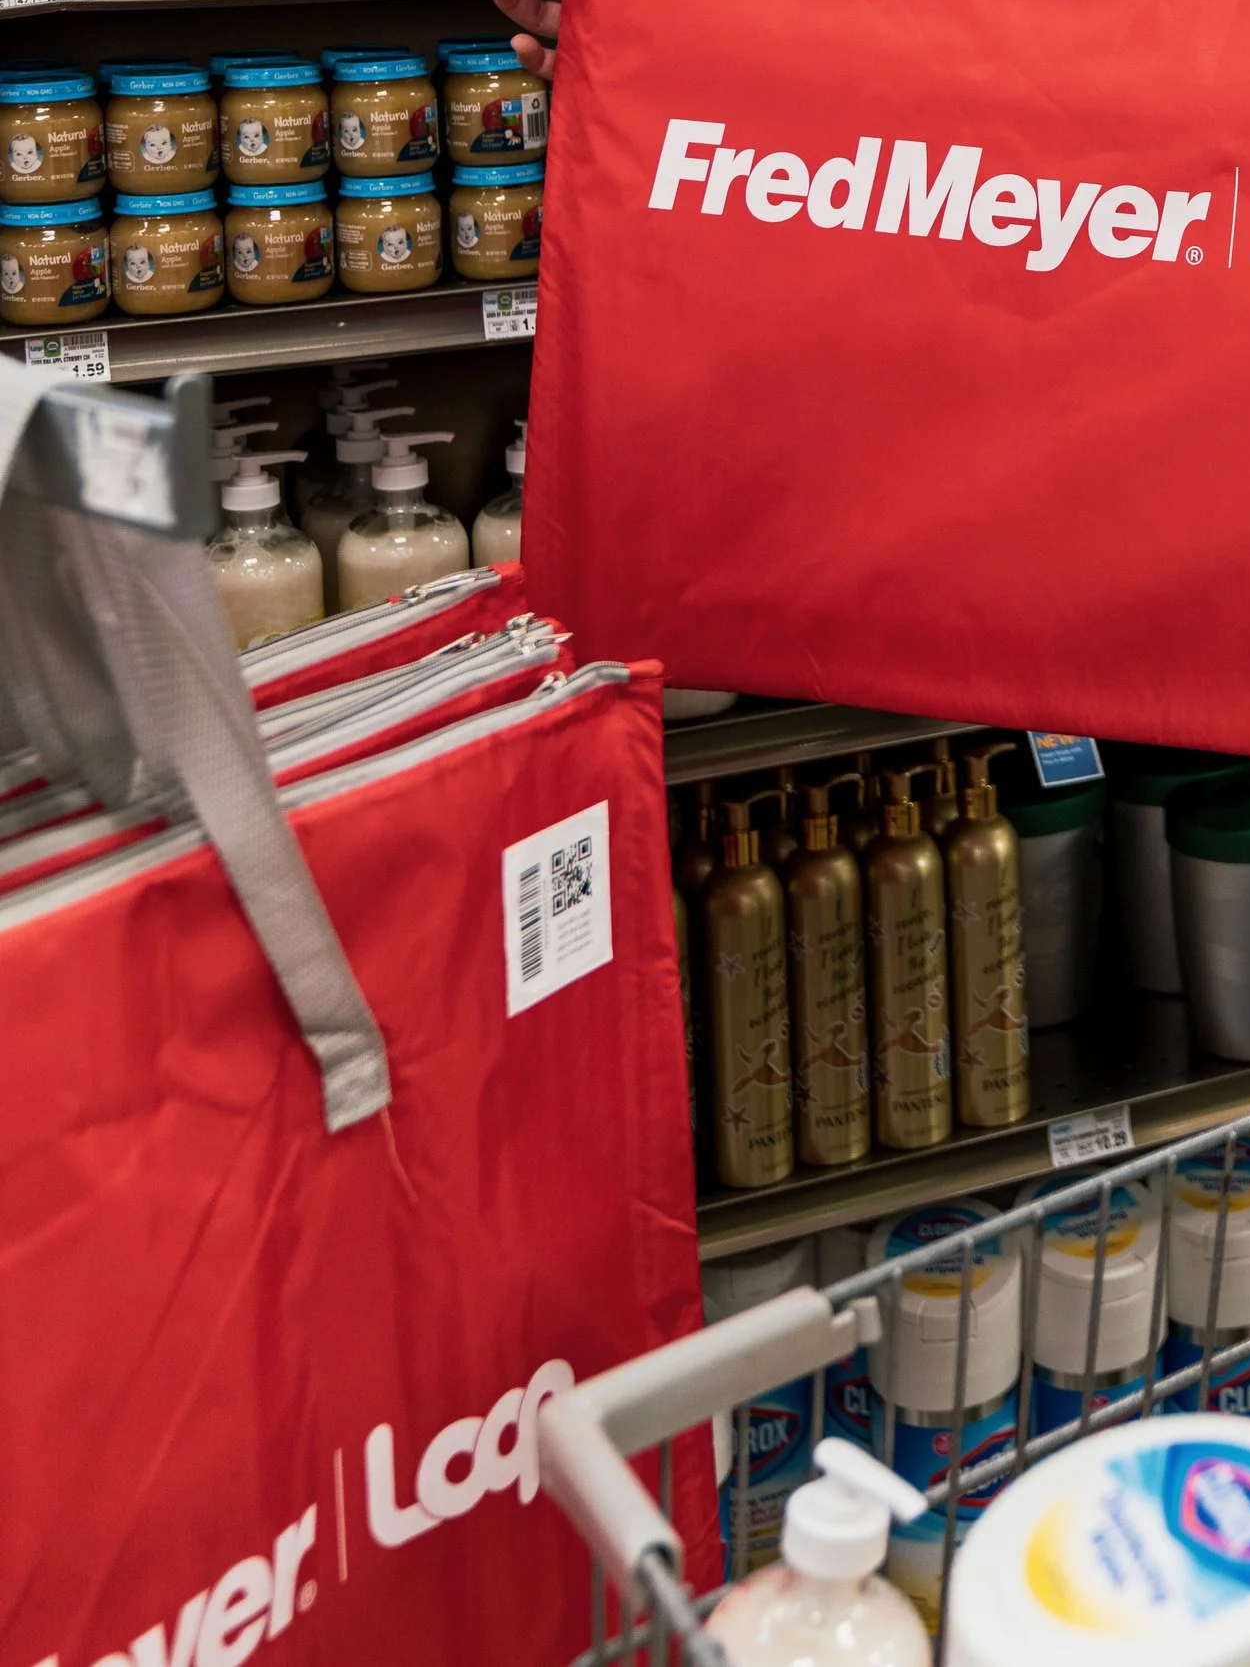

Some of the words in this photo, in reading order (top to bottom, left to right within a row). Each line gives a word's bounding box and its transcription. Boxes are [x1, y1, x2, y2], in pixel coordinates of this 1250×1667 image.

[274, 114, 312, 128] Natural
[370, 109, 409, 123] Natural
[181, 118, 213, 134] Natural
[48, 128, 87, 143] Natural
[484, 209, 522, 223] Natural
[264, 231, 304, 245] Natural
[159, 240, 200, 254] Natural
[29, 252, 72, 267] Natural
